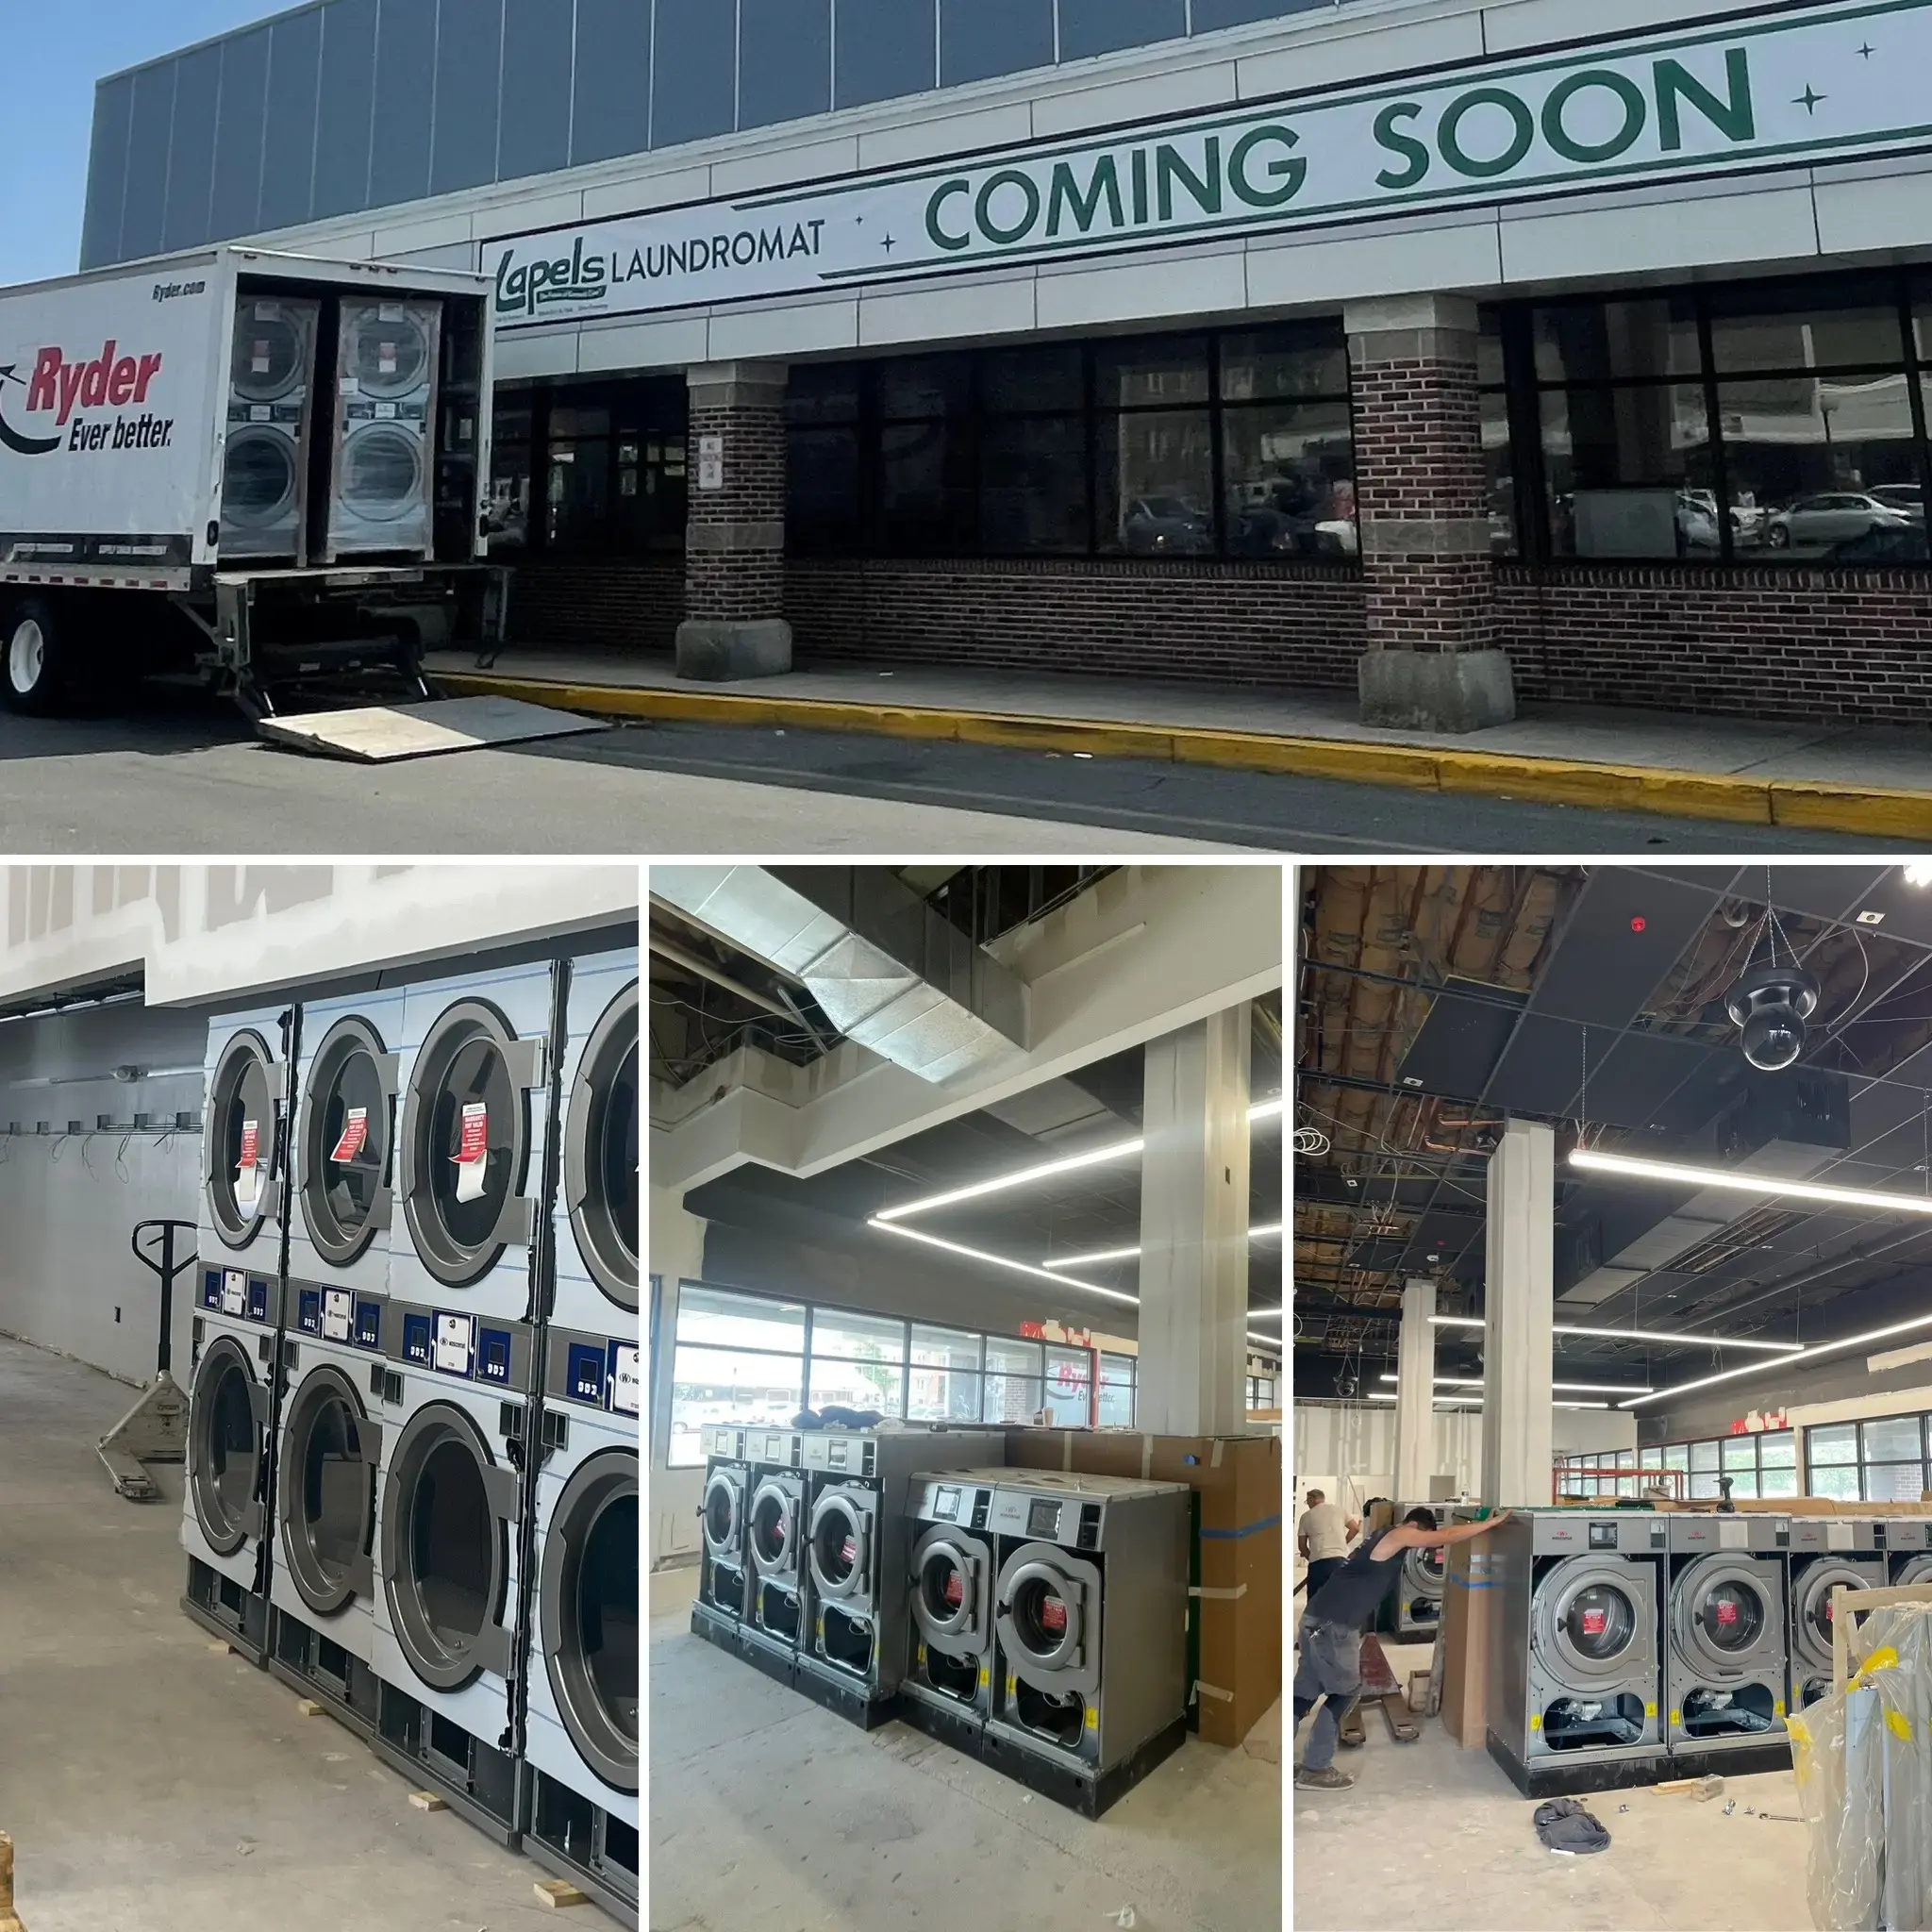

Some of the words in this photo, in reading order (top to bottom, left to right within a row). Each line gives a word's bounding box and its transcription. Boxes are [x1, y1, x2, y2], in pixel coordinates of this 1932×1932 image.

[926, 125, 1307, 251] COMING
[1374, 47, 1754, 189] SOON
[152, 281, 205, 302] Ryder.com
[495, 236, 606, 315] Lapels
[611, 219, 824, 283] LAUNDROMAT
[26, 340, 161, 425] Ryder
[68, 418, 110, 451] Ever
[111, 413, 174, 449] better.
